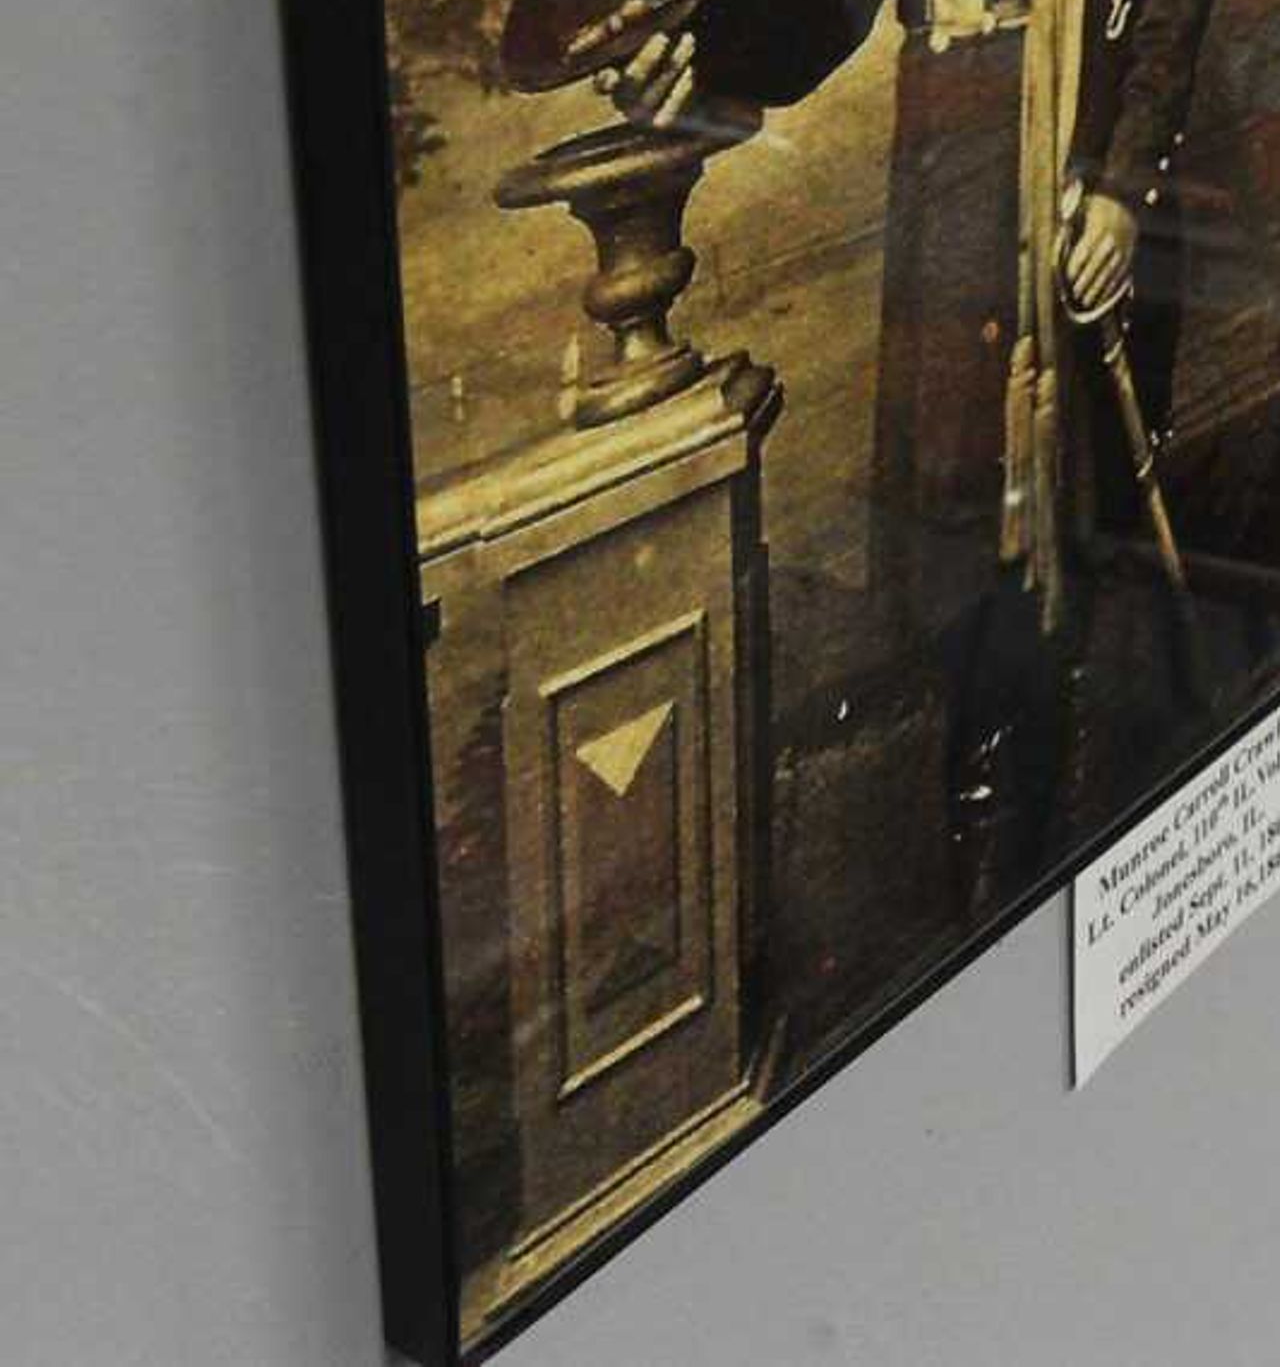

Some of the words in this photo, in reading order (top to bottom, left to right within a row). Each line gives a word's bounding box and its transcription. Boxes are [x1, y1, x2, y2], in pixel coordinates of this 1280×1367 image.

[1173, 764, 1230, 831] Carroll
[1116, 936, 1192, 1020] resigned
[1194, 898, 1232, 938] May
[1118, 907, 1185, 984] enlisted
